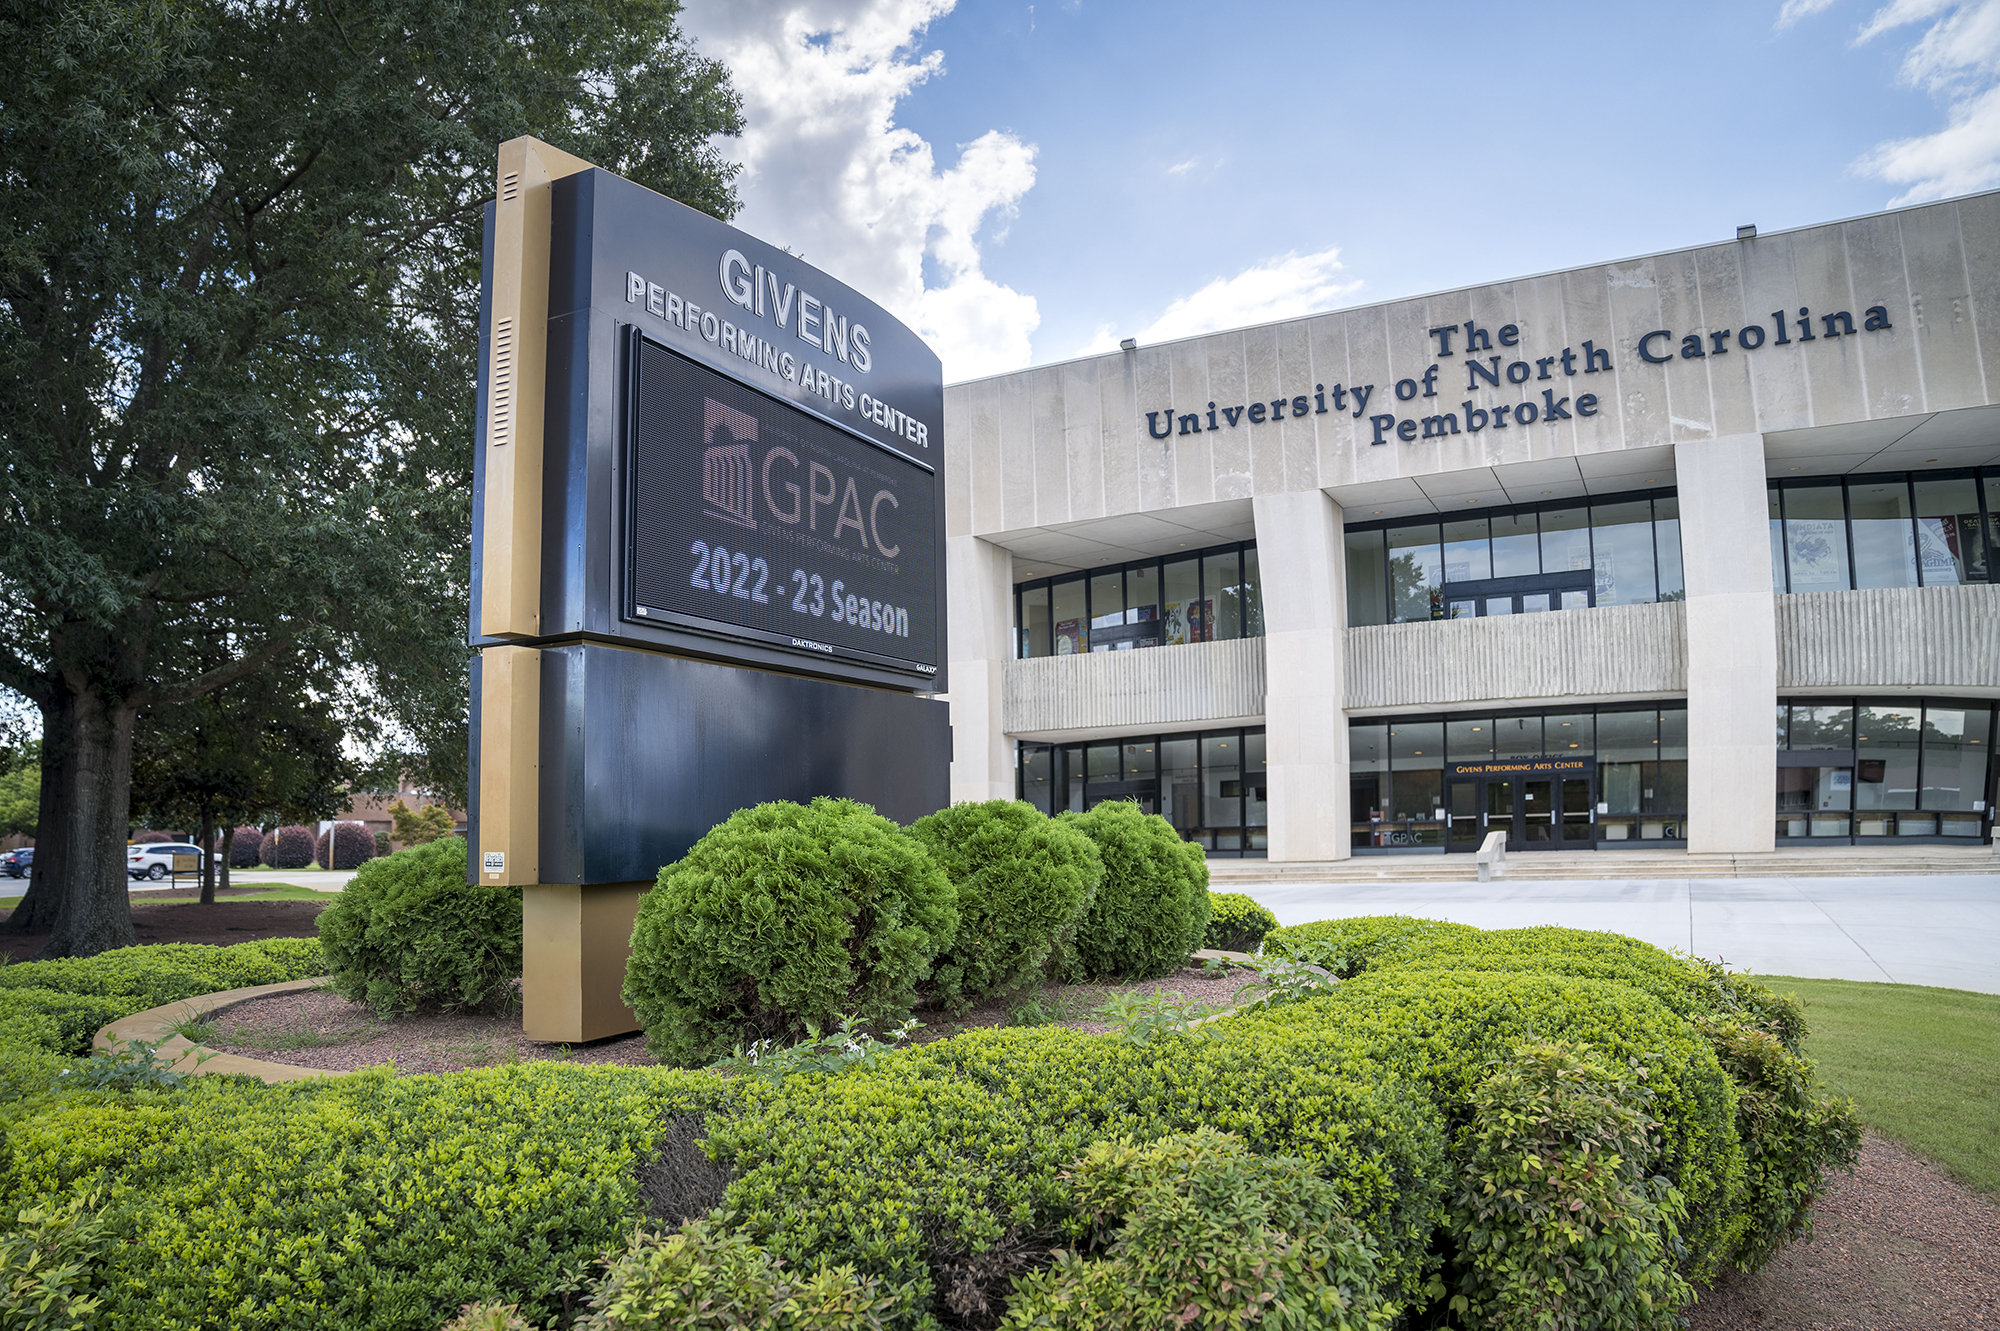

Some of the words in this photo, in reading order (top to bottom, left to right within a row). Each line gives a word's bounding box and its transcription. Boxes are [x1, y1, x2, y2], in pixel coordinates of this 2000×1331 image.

[626, 270, 796, 382] PERFORMING
[799, 362, 855, 411] ARTS
[858, 392, 929, 449] CENTER
[718, 248, 872, 374] GIVENS
[1429, 320, 1519, 357] The
[1145, 383, 1374, 440] University
[1395, 364, 1439, 401] of
[1465, 339, 1613, 390] North
[1637, 304, 1893, 363] Carolina
[1369, 388, 1599, 447] Pembroke
[762, 446, 900, 558] GPAC
[690, 540, 769, 604] 2022
[792, 569, 825, 617] 23
[831, 580, 909, 638] Season
[792, 638, 833, 653] DAKTRONICS
[1456, 765, 1483, 774] GIVENS
[1485, 763, 1531, 773] PERFORMING
[1533, 762, 1552, 771] ARTS
[1554, 761, 1583, 770] CENTER
